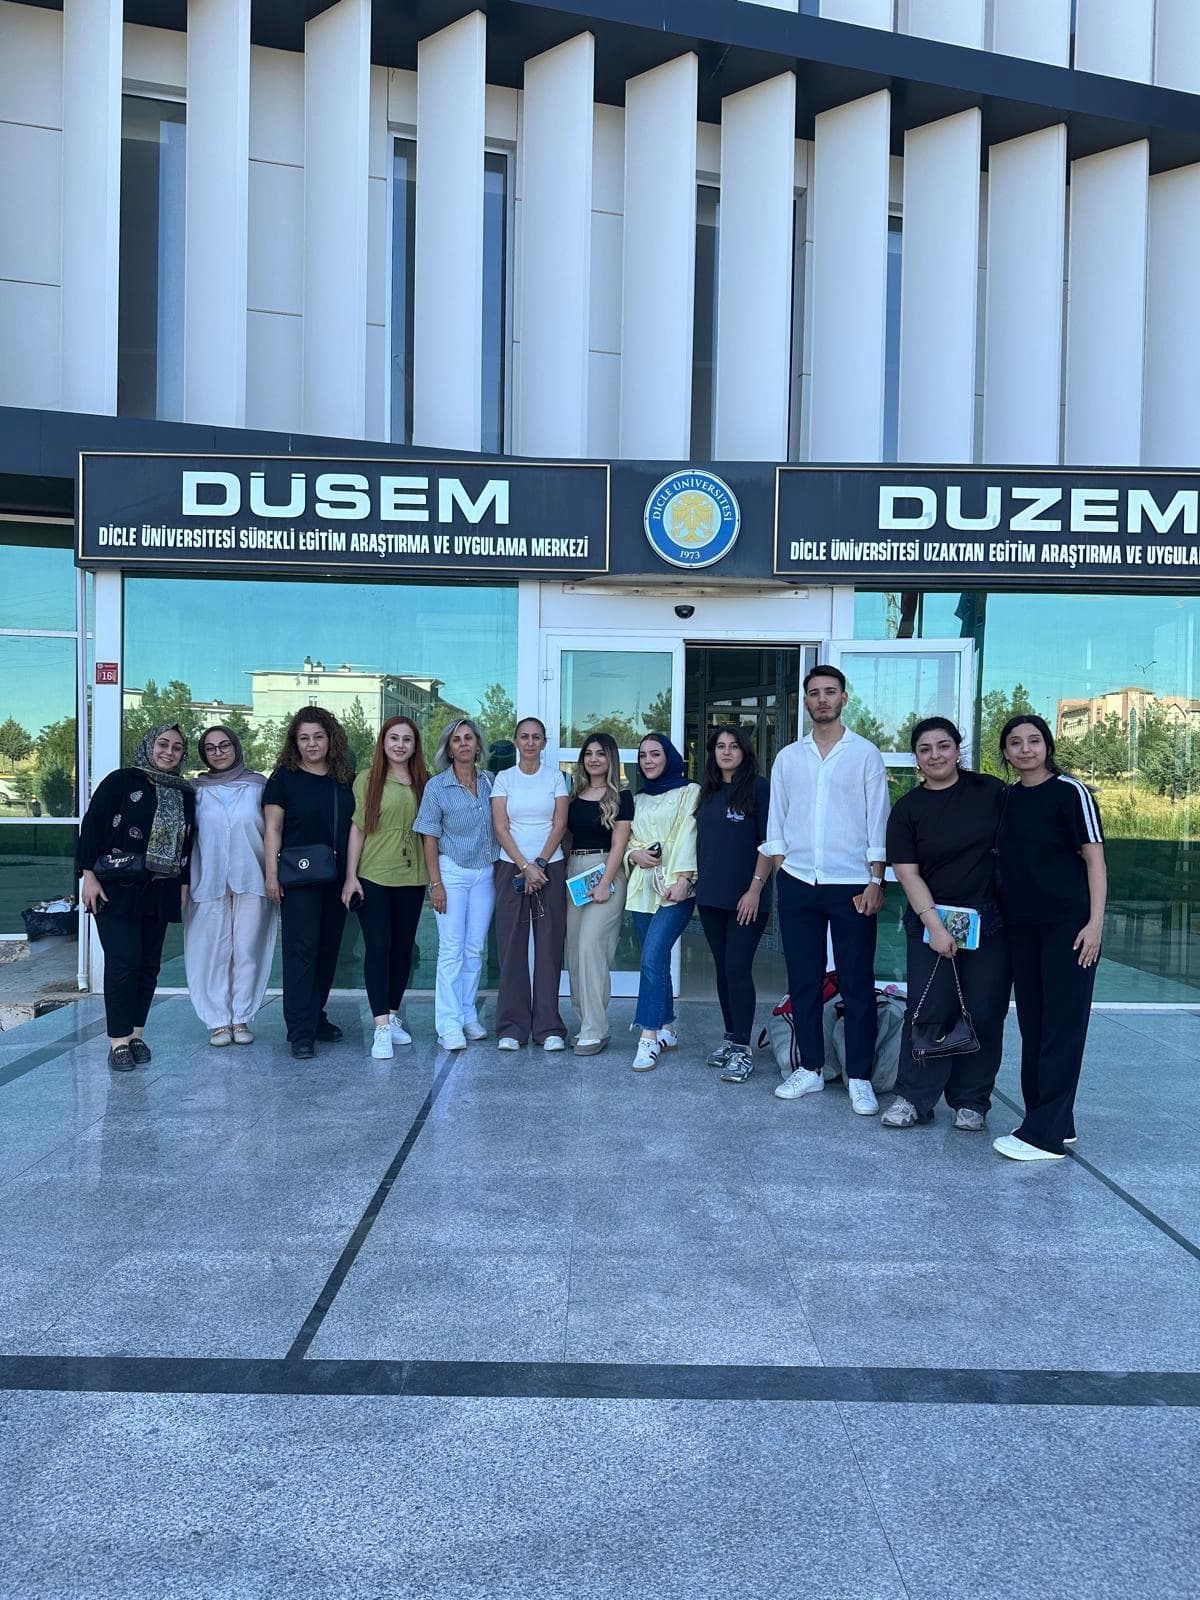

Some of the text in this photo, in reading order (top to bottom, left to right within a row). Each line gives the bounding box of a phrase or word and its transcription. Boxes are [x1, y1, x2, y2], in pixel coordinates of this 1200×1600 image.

[182, 471, 509, 525] DÜSEM
[652, 488, 674, 521] DİCLE
[879, 486, 1199, 534] DUZEM
[98, 524, 137, 546] DİCLE
[239, 527, 295, 550] SÜREKLİ
[350, 532, 430, 558] ARAŞTIRMA
[433, 535, 450, 554] VE
[454, 536, 528, 557] UYGULAMA
[531, 536, 589, 558] MERKEZİ
[680, 550, 701, 560] 1973
[790, 538, 827, 561] DİCLE
[830, 539, 920, 561] ÜNİVERSİTESİ
[923, 542, 985, 562] UZAKTAN
[1040, 543, 1122, 569] ARAŞTIRMA
[1126, 545, 1143, 564] VE
[1146, 545, 1200, 565] UYGULA
[102, 671, 113, 681] 16
